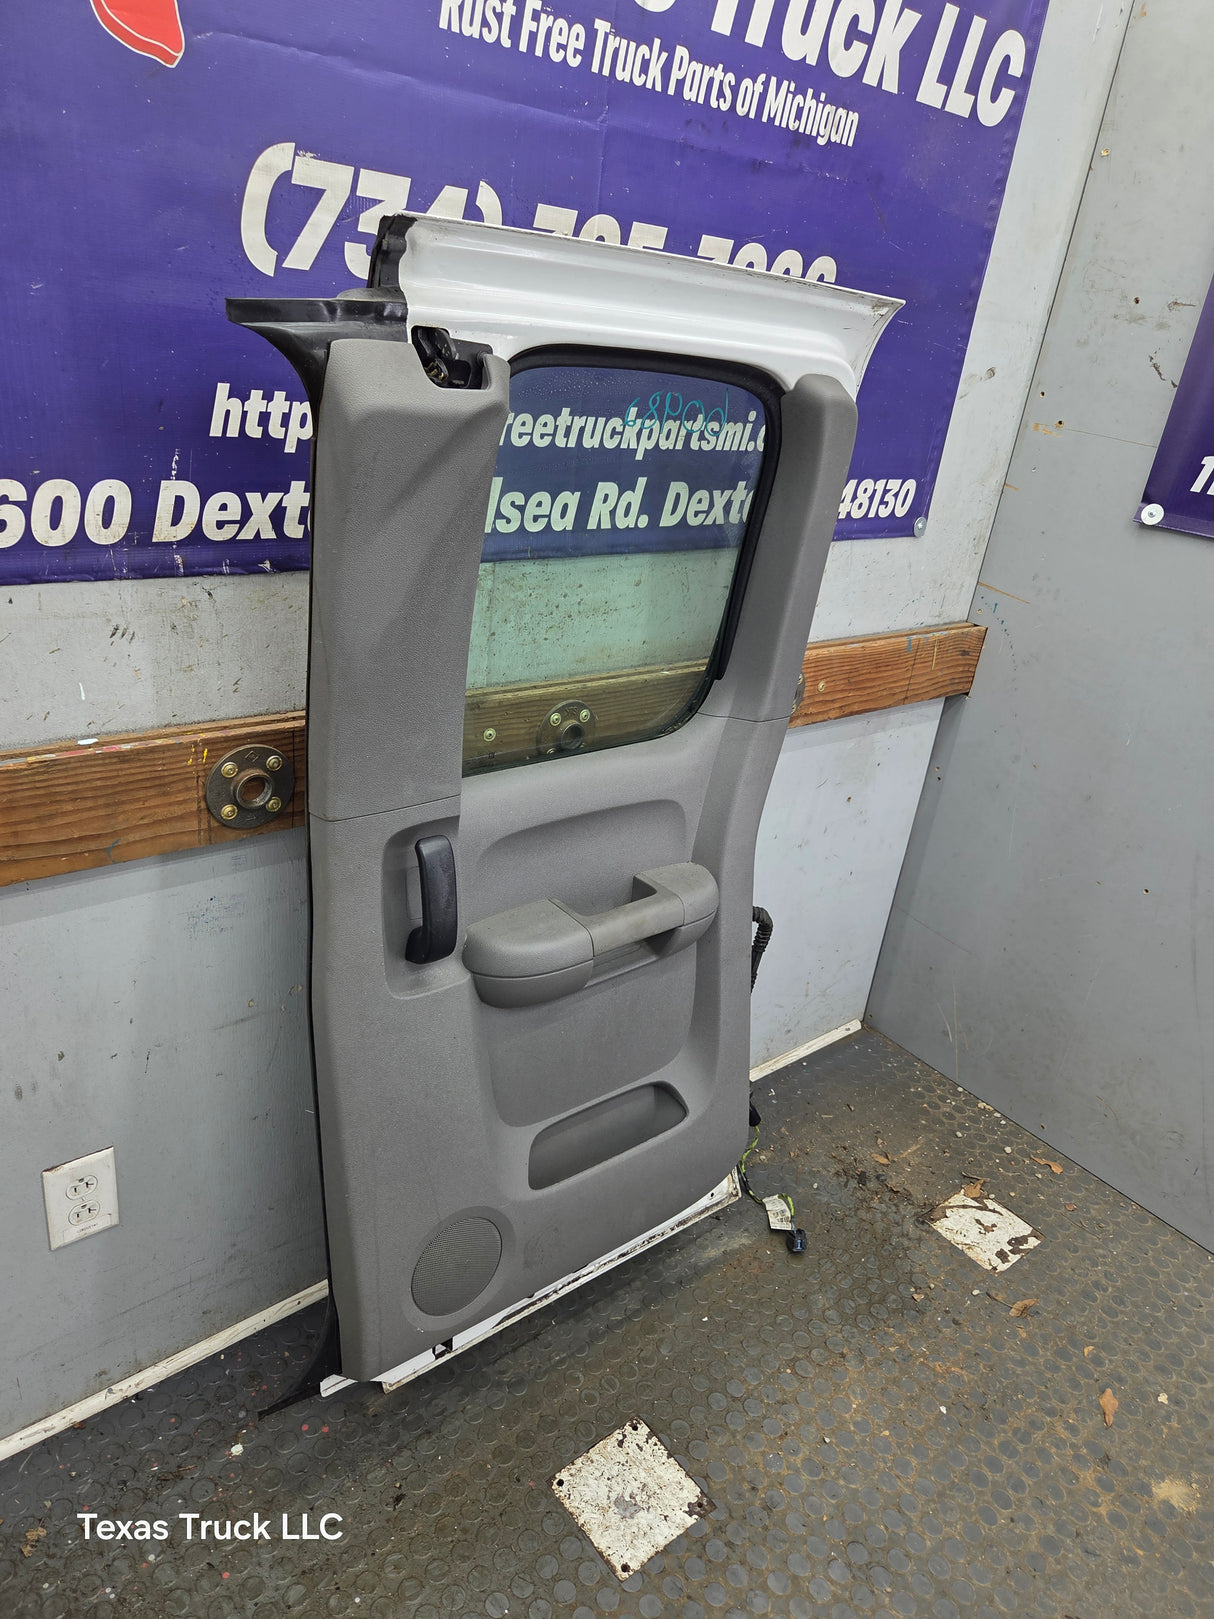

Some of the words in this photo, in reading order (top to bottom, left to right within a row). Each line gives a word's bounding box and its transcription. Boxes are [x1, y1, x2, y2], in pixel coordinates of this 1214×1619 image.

[439, 0, 516, 48] Rust
[519, 0, 586, 67] Free
[591, 18, 668, 92] Truck
[667, 44, 736, 111] Parts
[735, 73, 767, 119] of
[761, 75, 859, 147] Michigan
[916, 2, 1026, 127] LLC
[209, 382, 314, 453] http
[152, 480, 311, 542] Dext
[587, 476, 649, 530] Rd.
[838, 478, 917, 519] 48130
